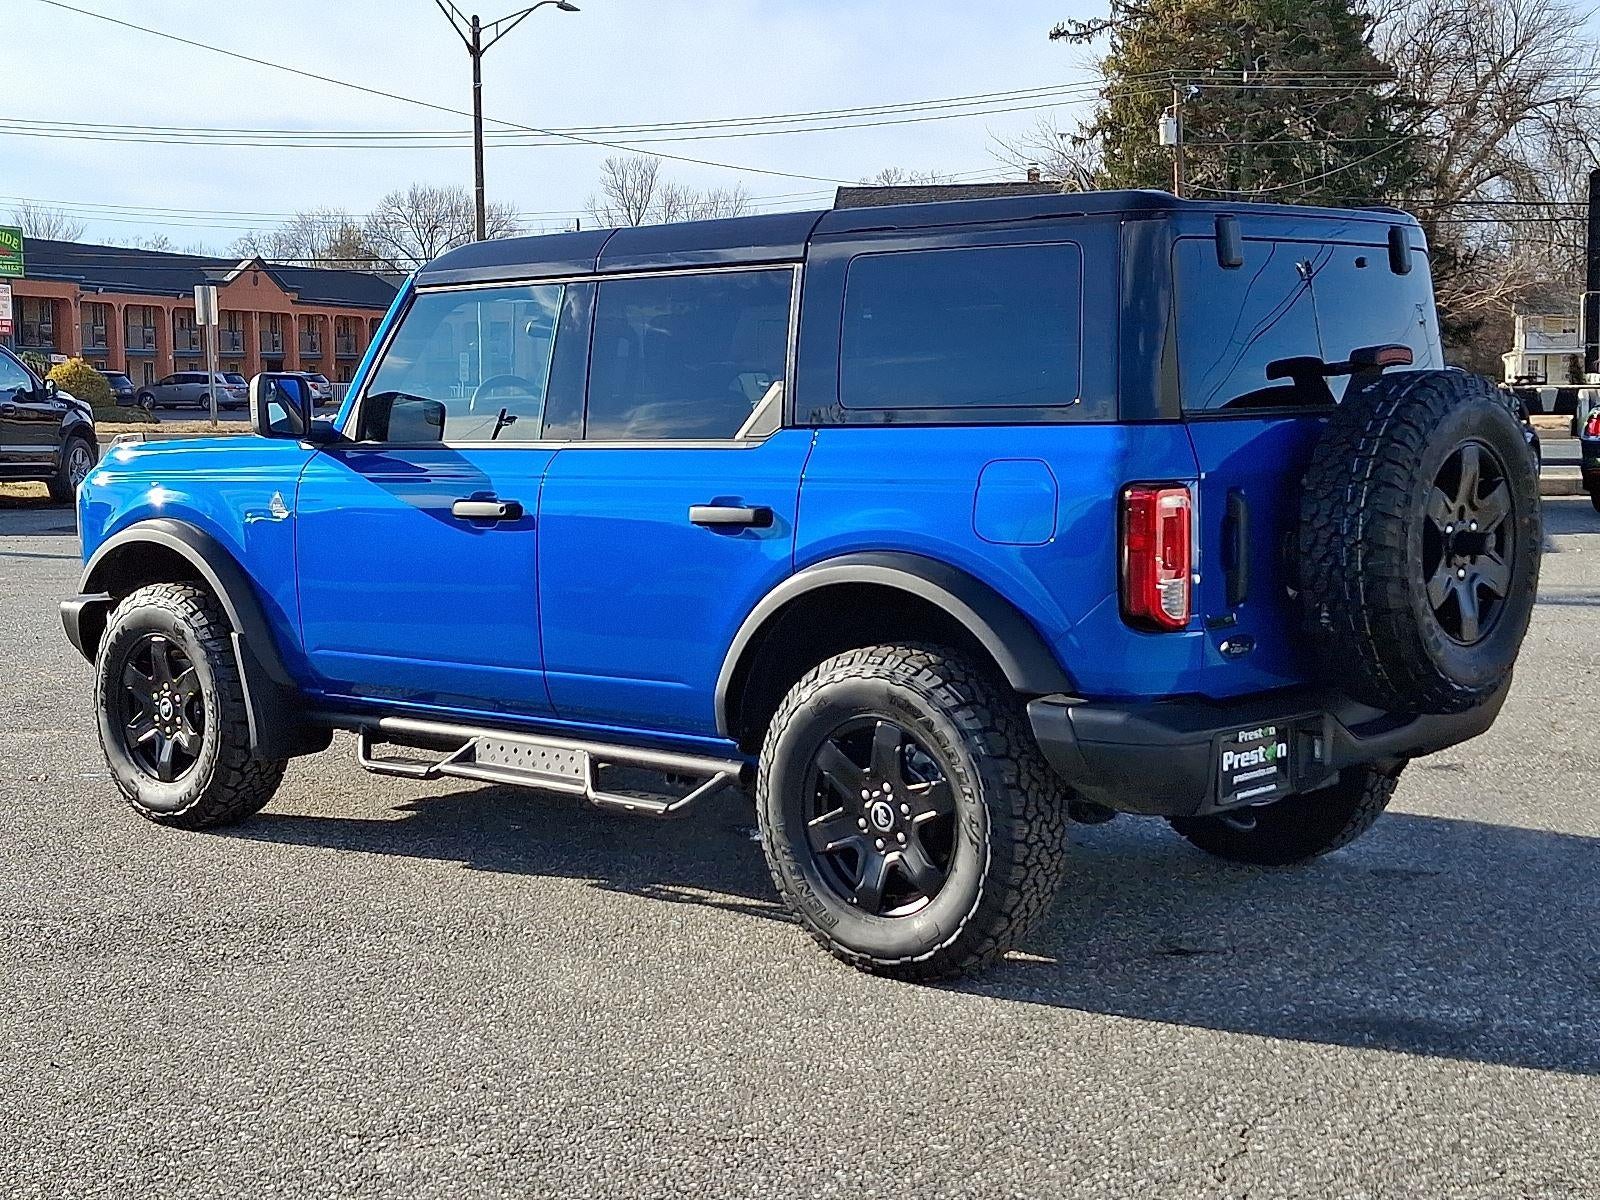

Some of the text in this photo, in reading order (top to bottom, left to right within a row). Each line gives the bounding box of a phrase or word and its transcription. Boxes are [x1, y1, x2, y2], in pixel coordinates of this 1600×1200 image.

[0, 231, 19, 249] IDE
[1238, 726, 1276, 743] Preston
[1222, 742, 1287, 772] Preston
